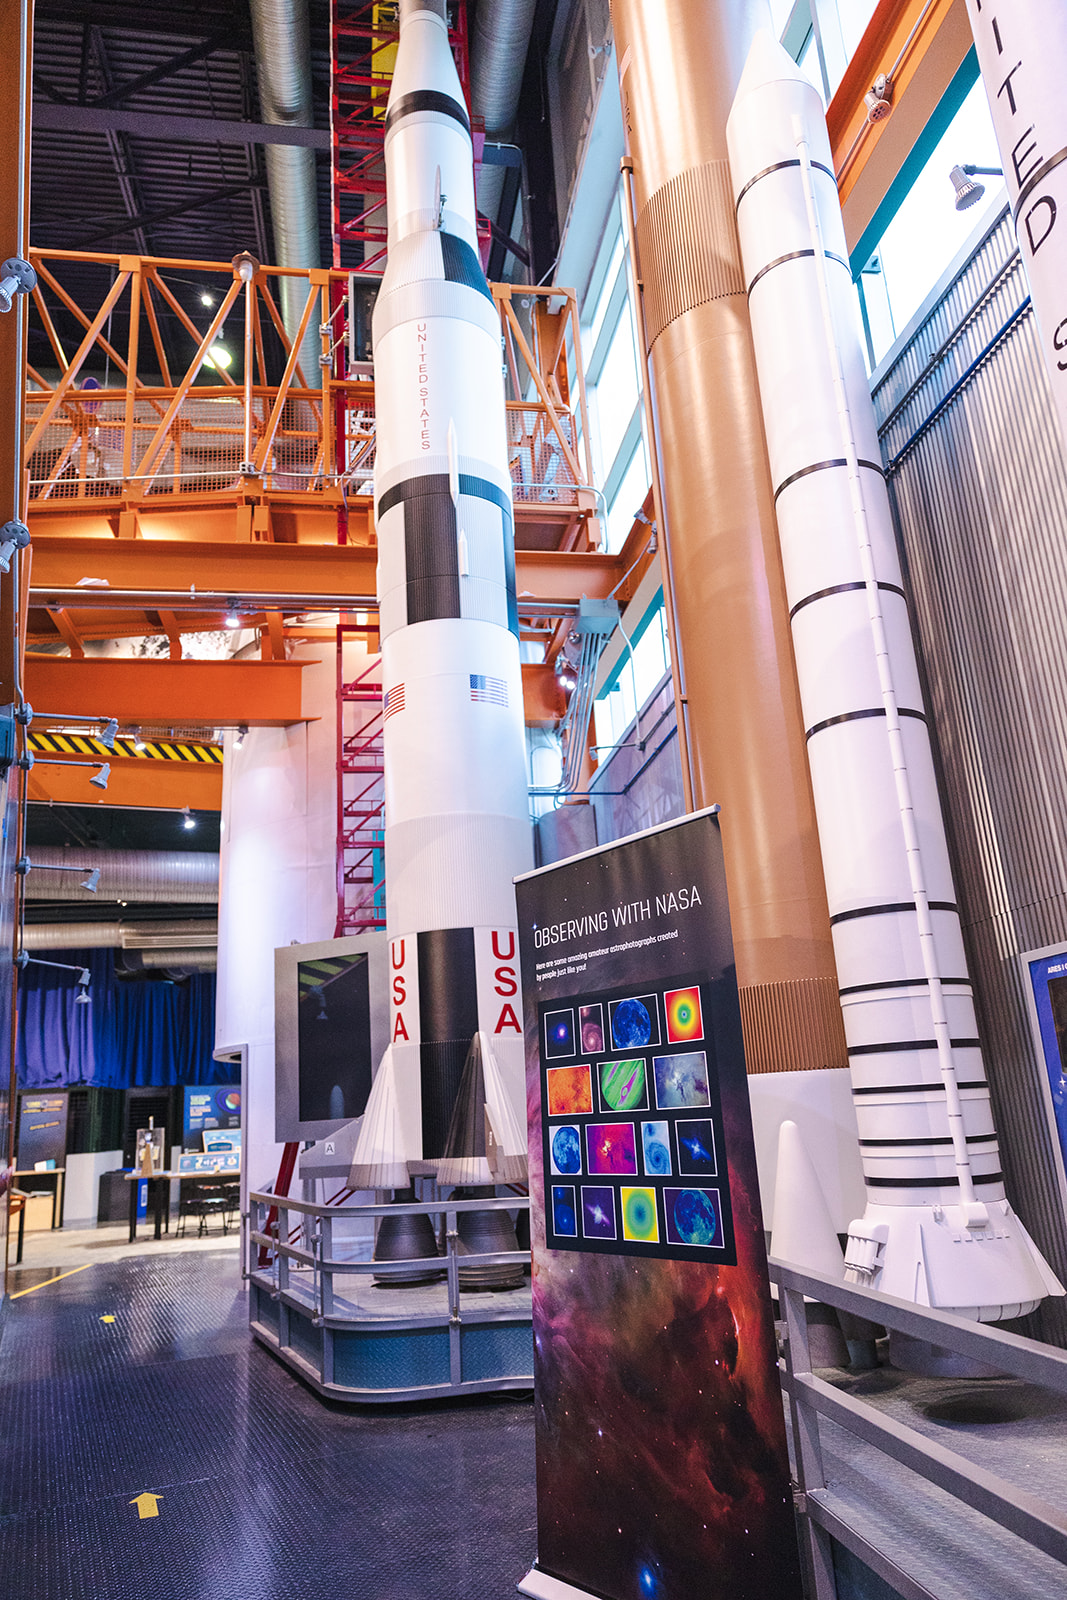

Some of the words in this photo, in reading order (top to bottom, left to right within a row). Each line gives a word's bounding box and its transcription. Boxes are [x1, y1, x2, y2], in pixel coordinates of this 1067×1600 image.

[976, 0, 1057, 256] ITED
[417, 323, 429, 384] UNITED
[420, 387, 431, 450] STATES
[534, 911, 608, 949] OBSERVING
[611, 899, 651, 928] WITH
[655, 885, 702, 918] NASA
[536, 962, 546, 970] Here
[546, 960, 554, 968] are
[554, 957, 567, 966] some
[567, 952, 588, 963] amazing
[588, 947, 610, 958] amateur
[609, 935, 657, 953] astrophotographs
[657, 929, 679, 942] created
[536, 973, 542, 982] by
[541, 970, 557, 981] people
[556, 968, 567, 978] just
[567, 966, 576, 974] like
[576, 963, 587, 974] you!
[391, 939, 410, 1043] USA
[491, 930, 523, 1034] USA
[326, 1143, 334, 1153] A
